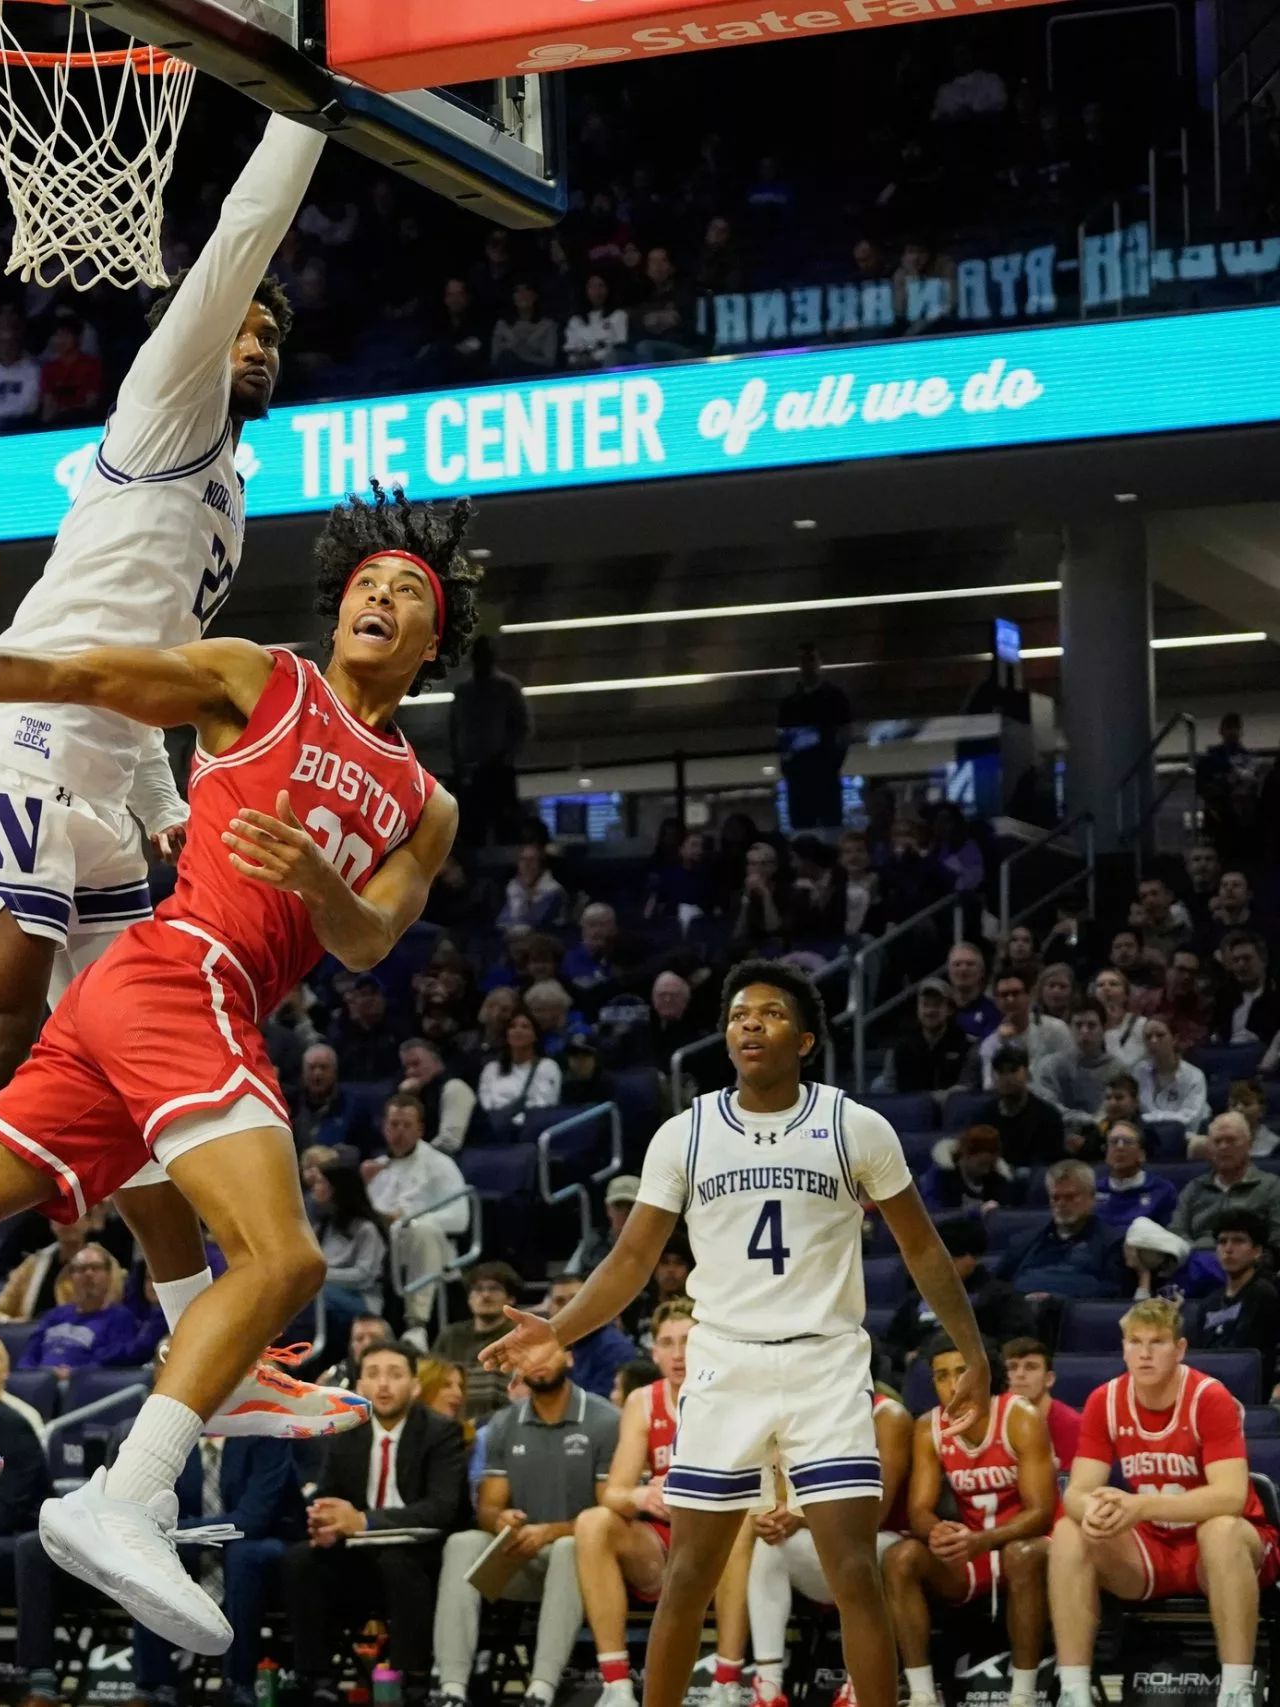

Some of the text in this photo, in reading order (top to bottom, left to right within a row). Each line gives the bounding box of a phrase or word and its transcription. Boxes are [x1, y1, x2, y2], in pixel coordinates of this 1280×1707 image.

[632, 9, 841, 51] State
[292, 404, 409, 498] THE
[425, 378, 666, 484] CENTER
[698, 378, 768, 455] of
[774, 373, 857, 431] all
[861, 375, 955, 423] we
[961, 358, 1044, 414] do
[15, 729, 48, 748] ROCK
[20, 715, 52, 732] POUND
[26, 725, 41, 736] THE
[290, 743, 410, 856] BOSTON
[697, 1167, 840, 1206] NORTHWESTERN
[747, 1200, 791, 1275] 4
[946, 1465, 1018, 1492] OSTON
[971, 1492, 999, 1531] 7
